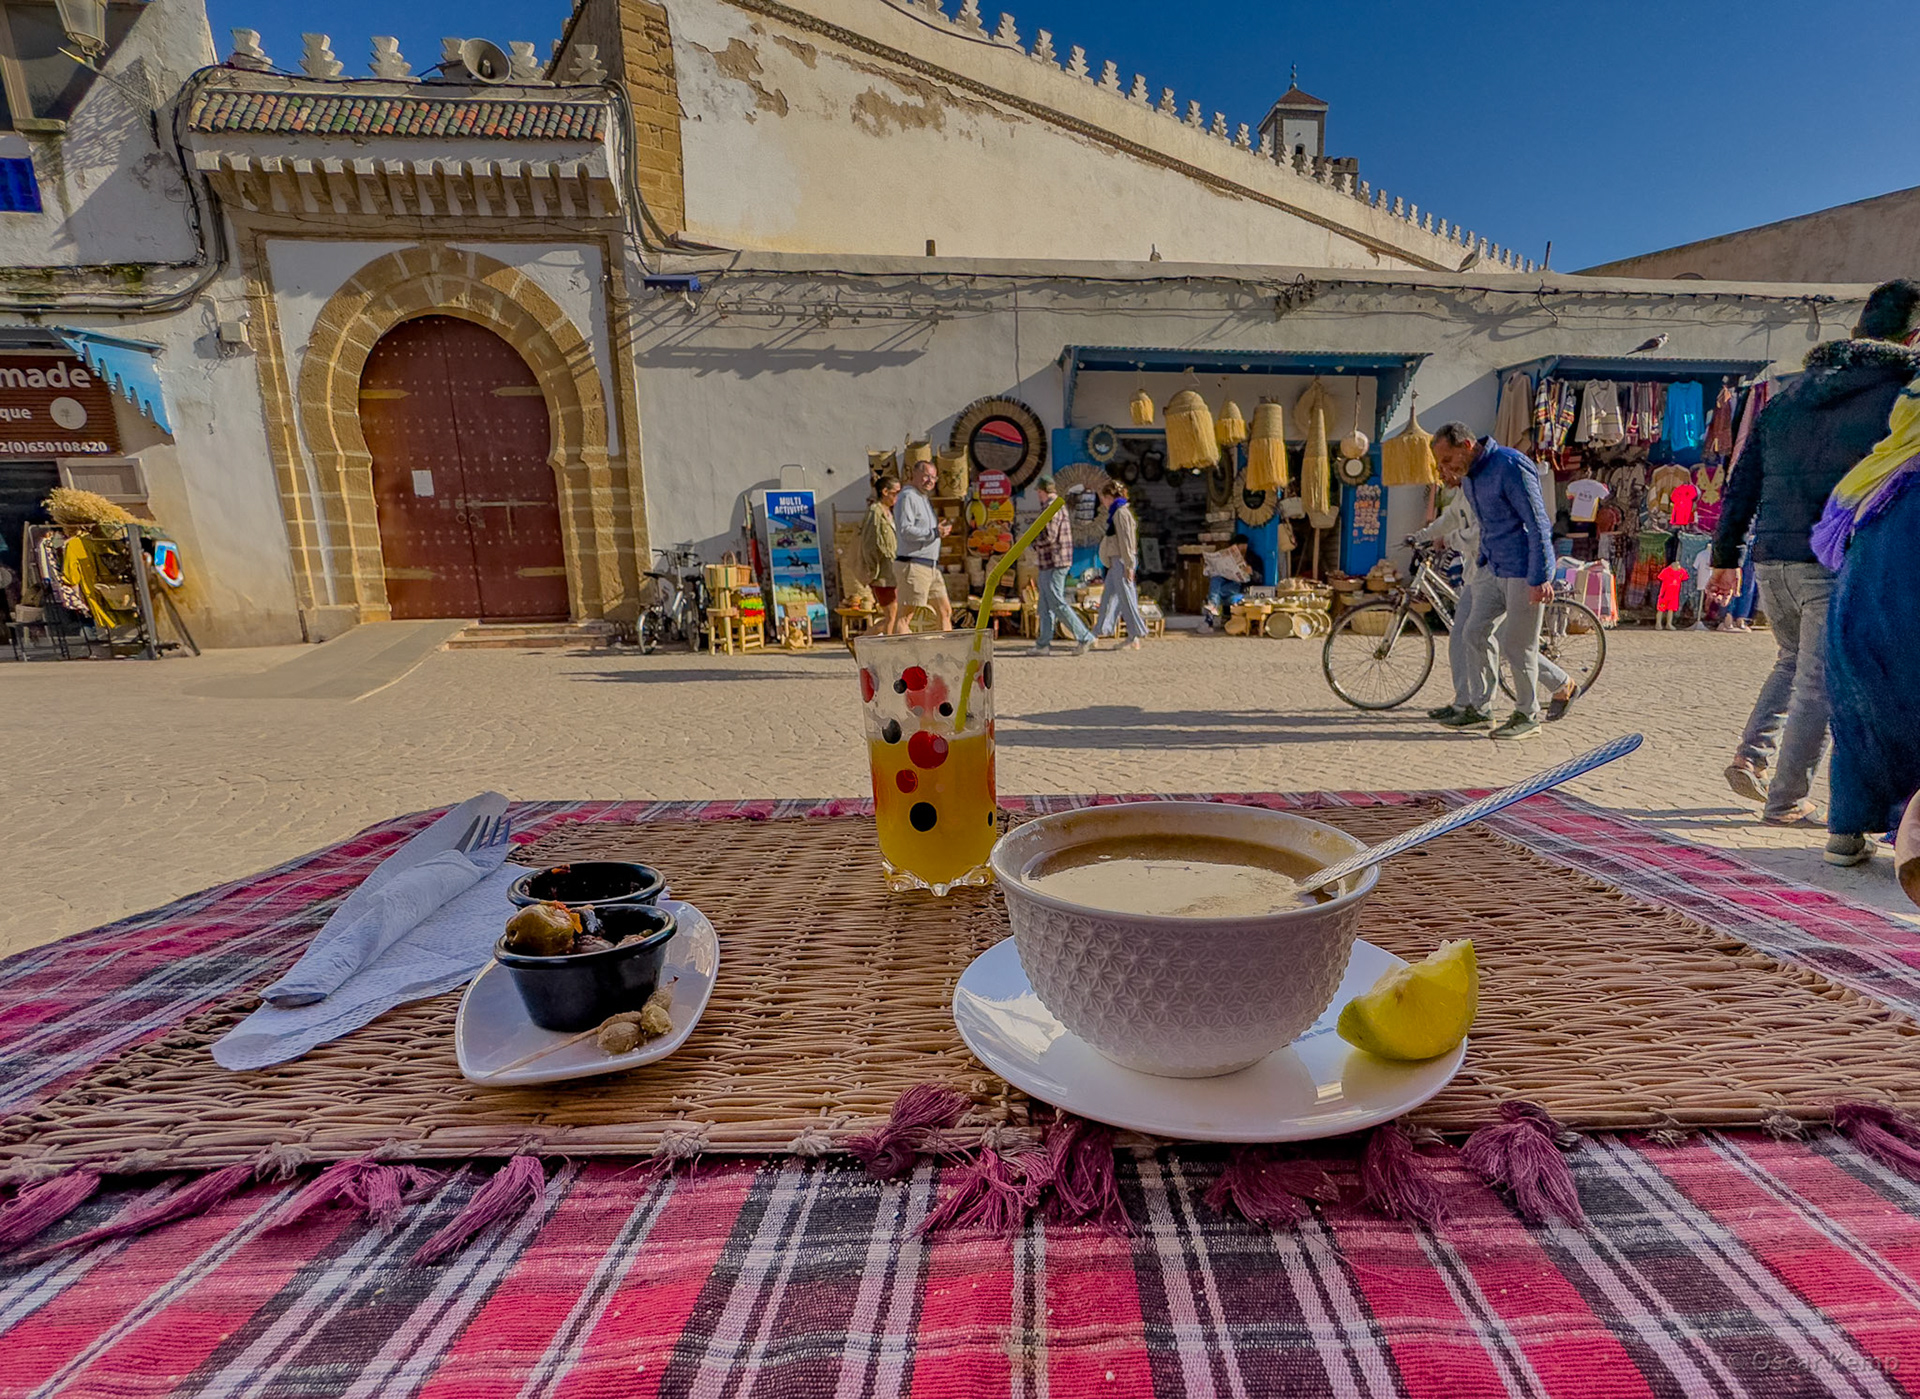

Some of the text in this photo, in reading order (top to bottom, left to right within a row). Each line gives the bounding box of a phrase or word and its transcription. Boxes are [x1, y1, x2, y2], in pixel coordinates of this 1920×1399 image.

[0, 361, 92, 388] made
[0, 408, 32, 422] que
[0, 441, 108, 454] 2(0)650108420
[779, 496, 802, 506] MULTI
